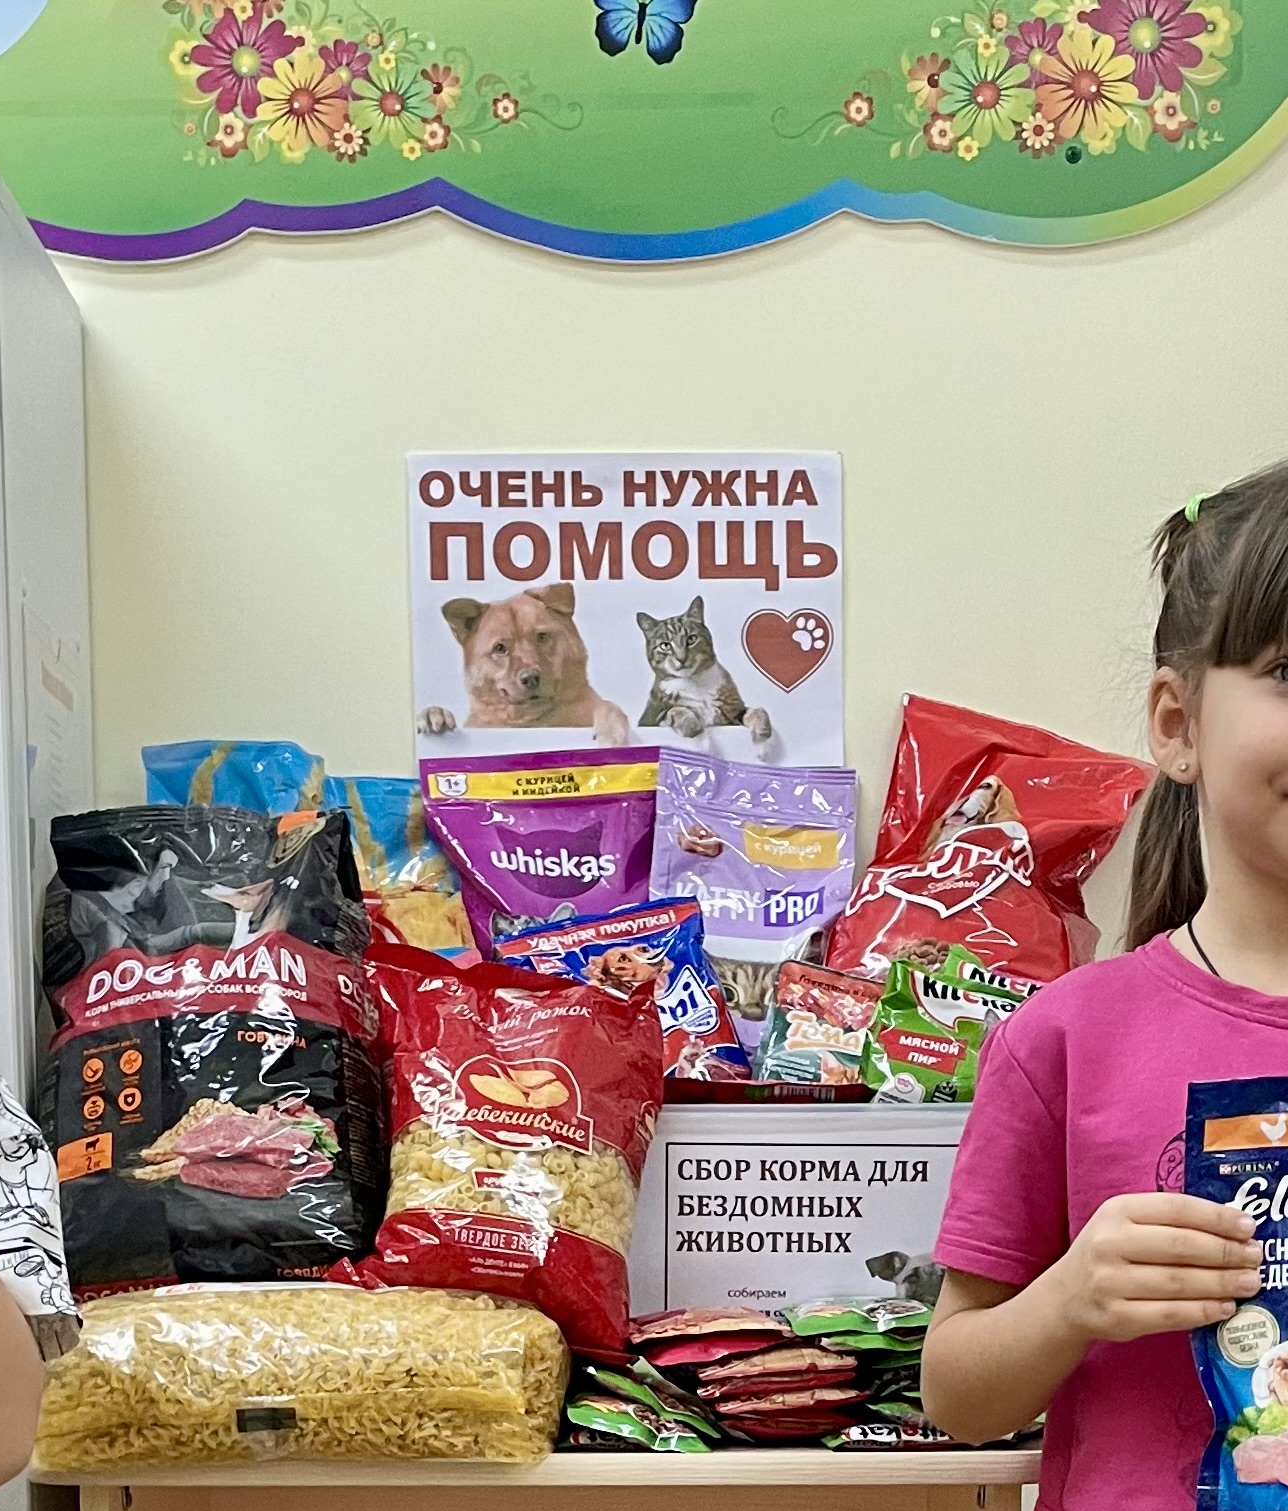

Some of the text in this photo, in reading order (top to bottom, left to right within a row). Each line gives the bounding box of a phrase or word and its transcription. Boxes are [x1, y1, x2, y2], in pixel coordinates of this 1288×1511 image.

[418, 468, 819, 508] ОЧЕНЬ НУЖНА
[428, 519, 839, 592] ПОМОЩЬ
[522, 785, 580, 796] ИНДЕЙКОЙ
[525, 773, 576, 787] КУРИЦЕЙ
[490, 847, 617, 882] whiskas
[675, 882, 820, 924] KATTY PRO
[527, 909, 677, 950] Удачная покупка!
[110, 986, 184, 1011] УНИВЕРСАЛЬНЫ
[208, 982, 243, 994] СОБАК
[923, 974, 1016, 1013] kiteka
[528, 1005, 594, 1029] рожок
[237, 1030, 307, 1049] ГОВНА
[899, 1034, 961, 1056] МЯСНОЙ
[908, 1051, 938, 1066] ПИР
[456, 1104, 586, 1142] ебекинские
[677, 1158, 929, 1186] СБОР КОРМА ДЛЯ
[1231, 1162, 1274, 1174] PURINA
[677, 1194, 864, 1222] БЕЗДОМНЫХ
[454, 1227, 507, 1248] ТВЕРДОЕ
[676, 1230, 852, 1253] ЖИВОТНЫХ
[727, 1287, 787, 1300] собираем
